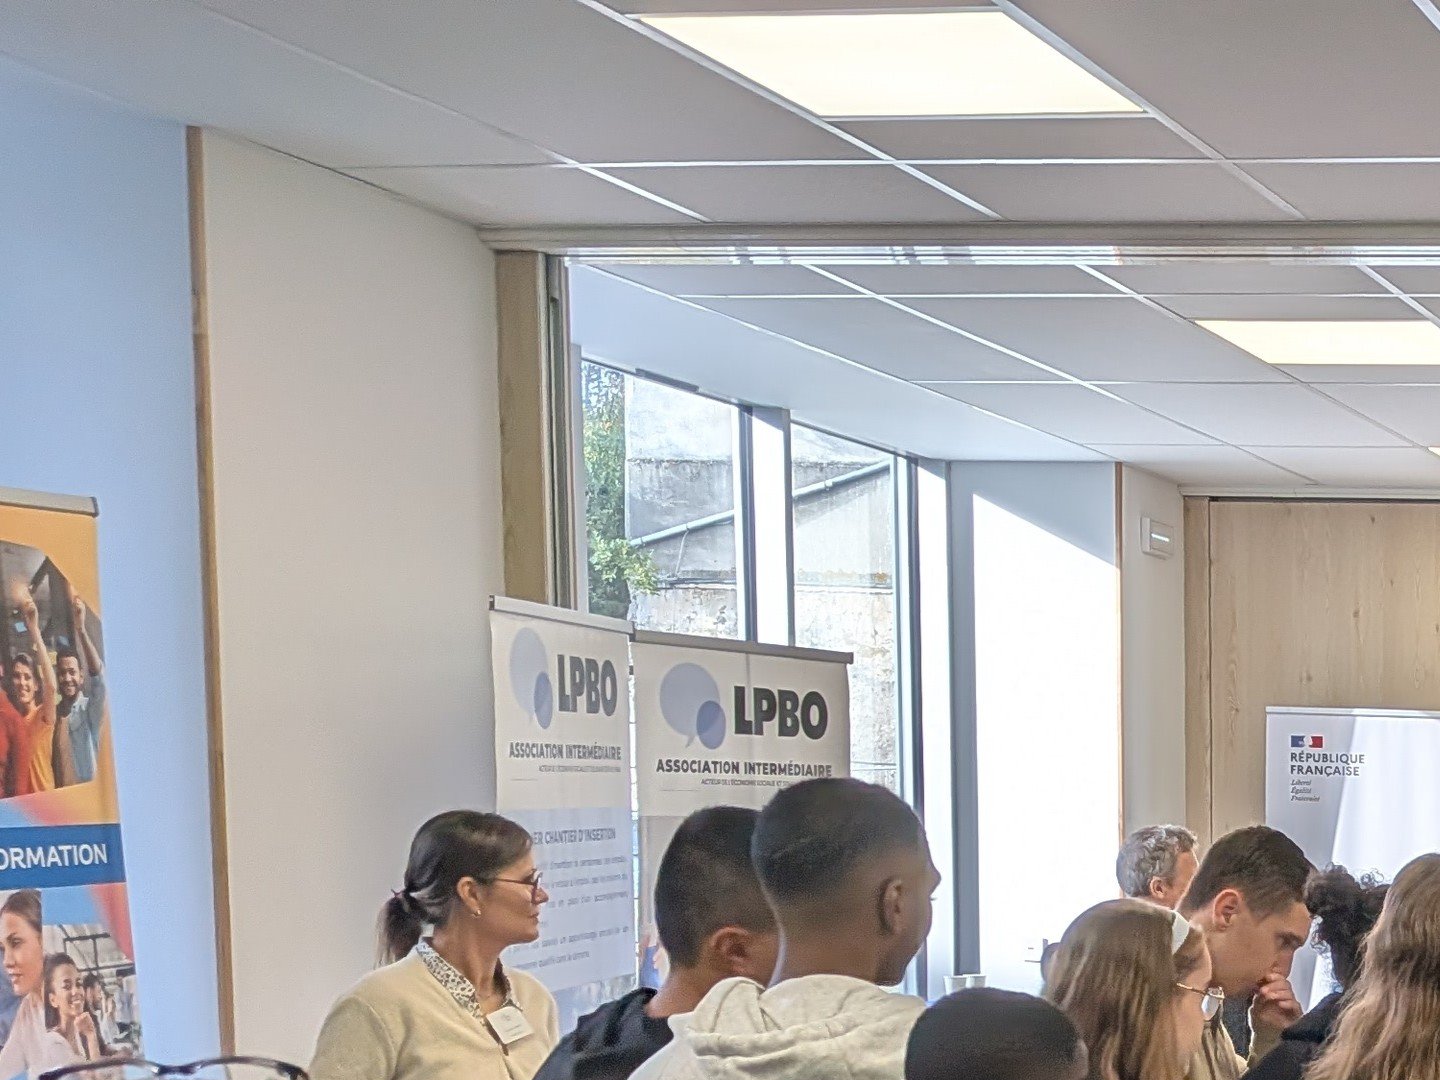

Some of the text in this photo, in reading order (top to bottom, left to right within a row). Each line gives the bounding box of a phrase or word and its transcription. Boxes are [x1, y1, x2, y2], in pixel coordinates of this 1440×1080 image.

[557, 654, 617, 716] LPBO
[734, 686, 828, 740] LPBO
[509, 741, 621, 760] ASSOCIATION INTERMÉDIAIRE
[1290, 750, 1365, 765] RÉPUBLIQUE
[656, 759, 832, 778] ASSOCIATION INTERMÉDIAIRE
[1290, 765, 1360, 777] FRANÇAISE
